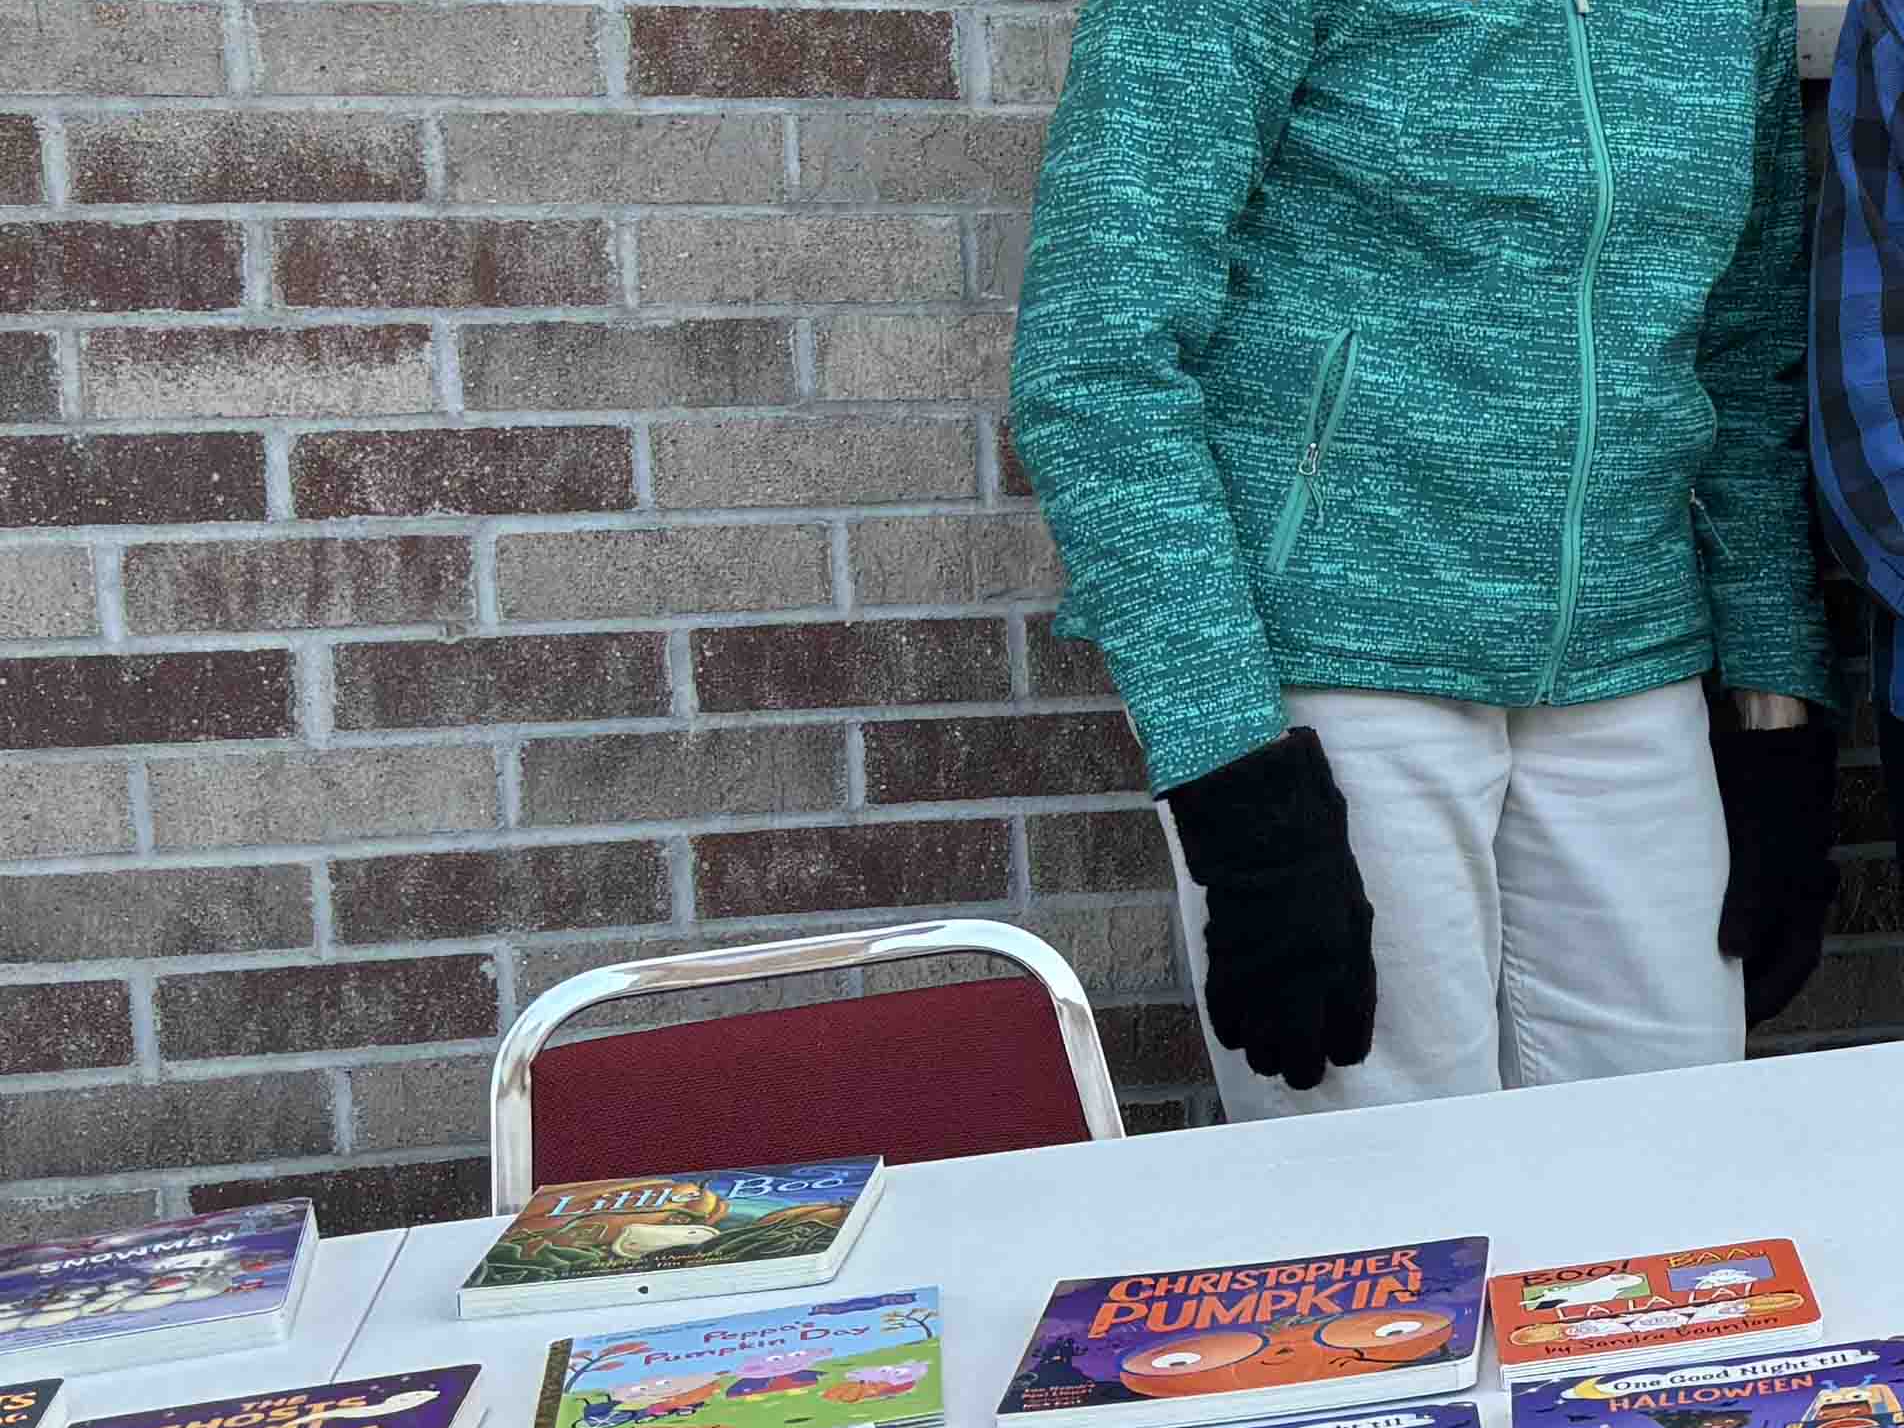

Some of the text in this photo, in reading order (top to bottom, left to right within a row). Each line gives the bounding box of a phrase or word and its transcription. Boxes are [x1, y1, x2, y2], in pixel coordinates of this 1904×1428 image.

[547, 1173, 848, 1219] Little Boo
[39, 1232, 235, 1274] SNOWMEN
[1106, 1248, 1424, 1306] CHRISTOPHER
[1520, 1259, 1631, 1287] BOO!
[1087, 1269, 1425, 1340] PUMPKIN
[1554, 1303, 1615, 1321] LA
[1627, 1295, 1677, 1313] LA
[642, 1324, 873, 1366] Pumpkin Day
[703, 1319, 817, 1345] Peppa's
[1543, 1344, 1571, 1356] by
[1580, 1330, 1667, 1350] Sandra
[1607, 1372, 1817, 1414] HALLOWEEN
[1612, 1377, 1663, 1393] One
[1669, 1368, 1730, 1387] Good
[1737, 1359, 1810, 1382] Night
[240, 1394, 308, 1413] THE
